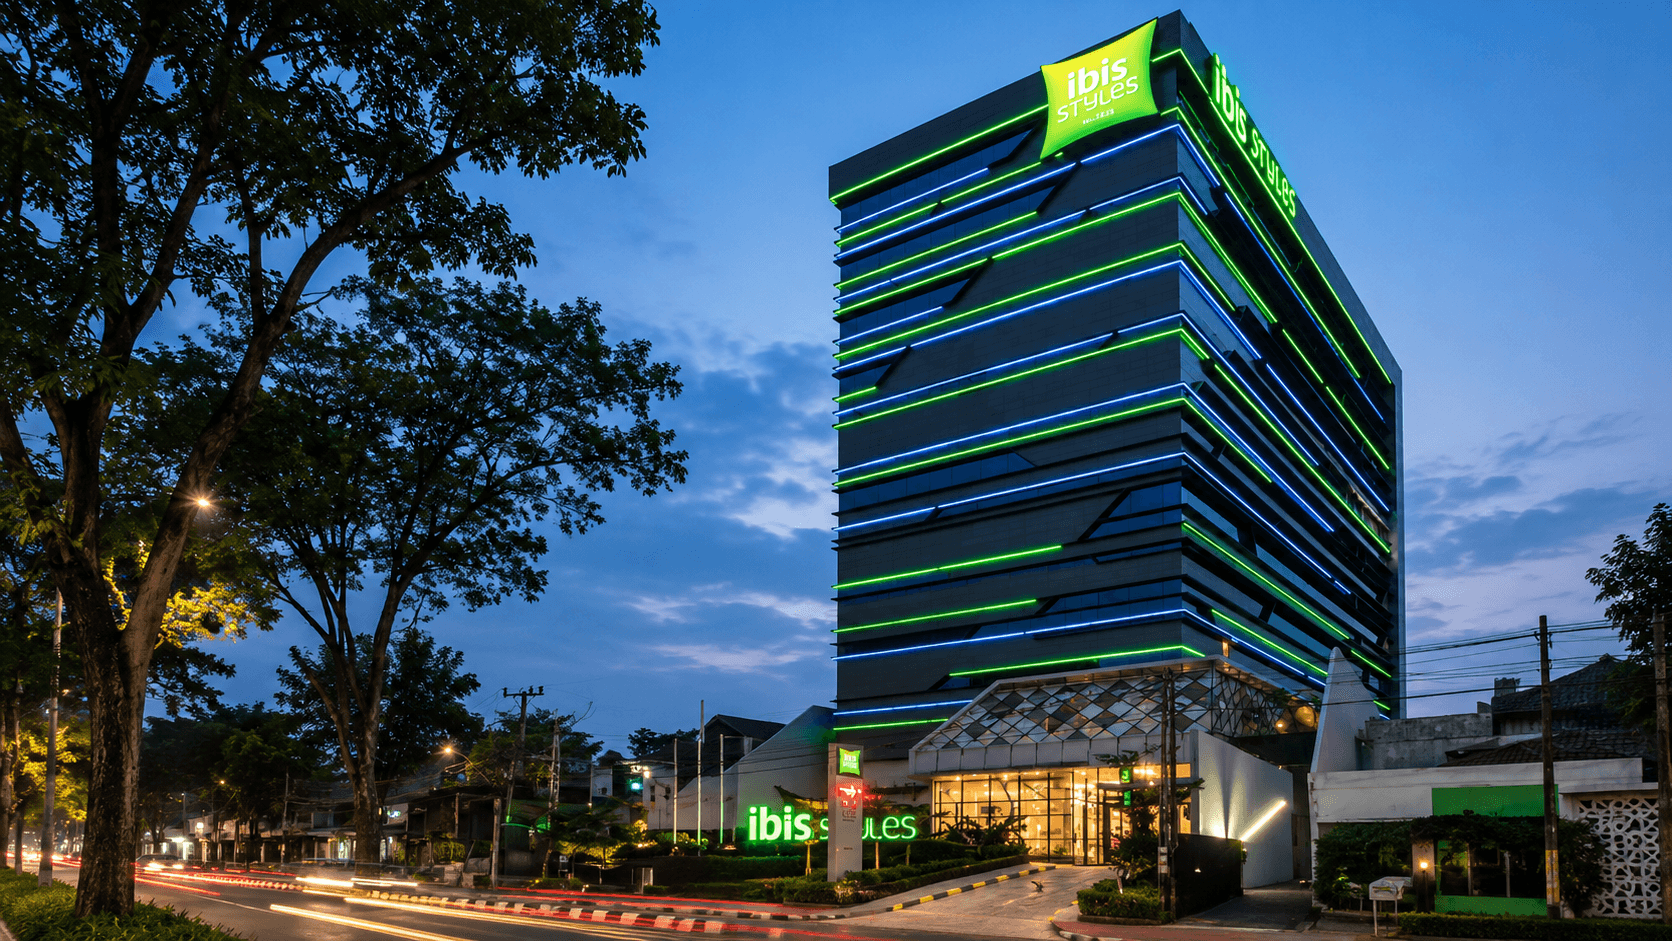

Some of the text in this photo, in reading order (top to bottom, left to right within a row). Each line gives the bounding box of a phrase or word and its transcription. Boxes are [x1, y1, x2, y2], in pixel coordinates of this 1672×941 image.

[1068, 57, 1127, 100] ibis
[1214, 53, 1247, 143] ibis
[749, 806, 812, 841] ibis
